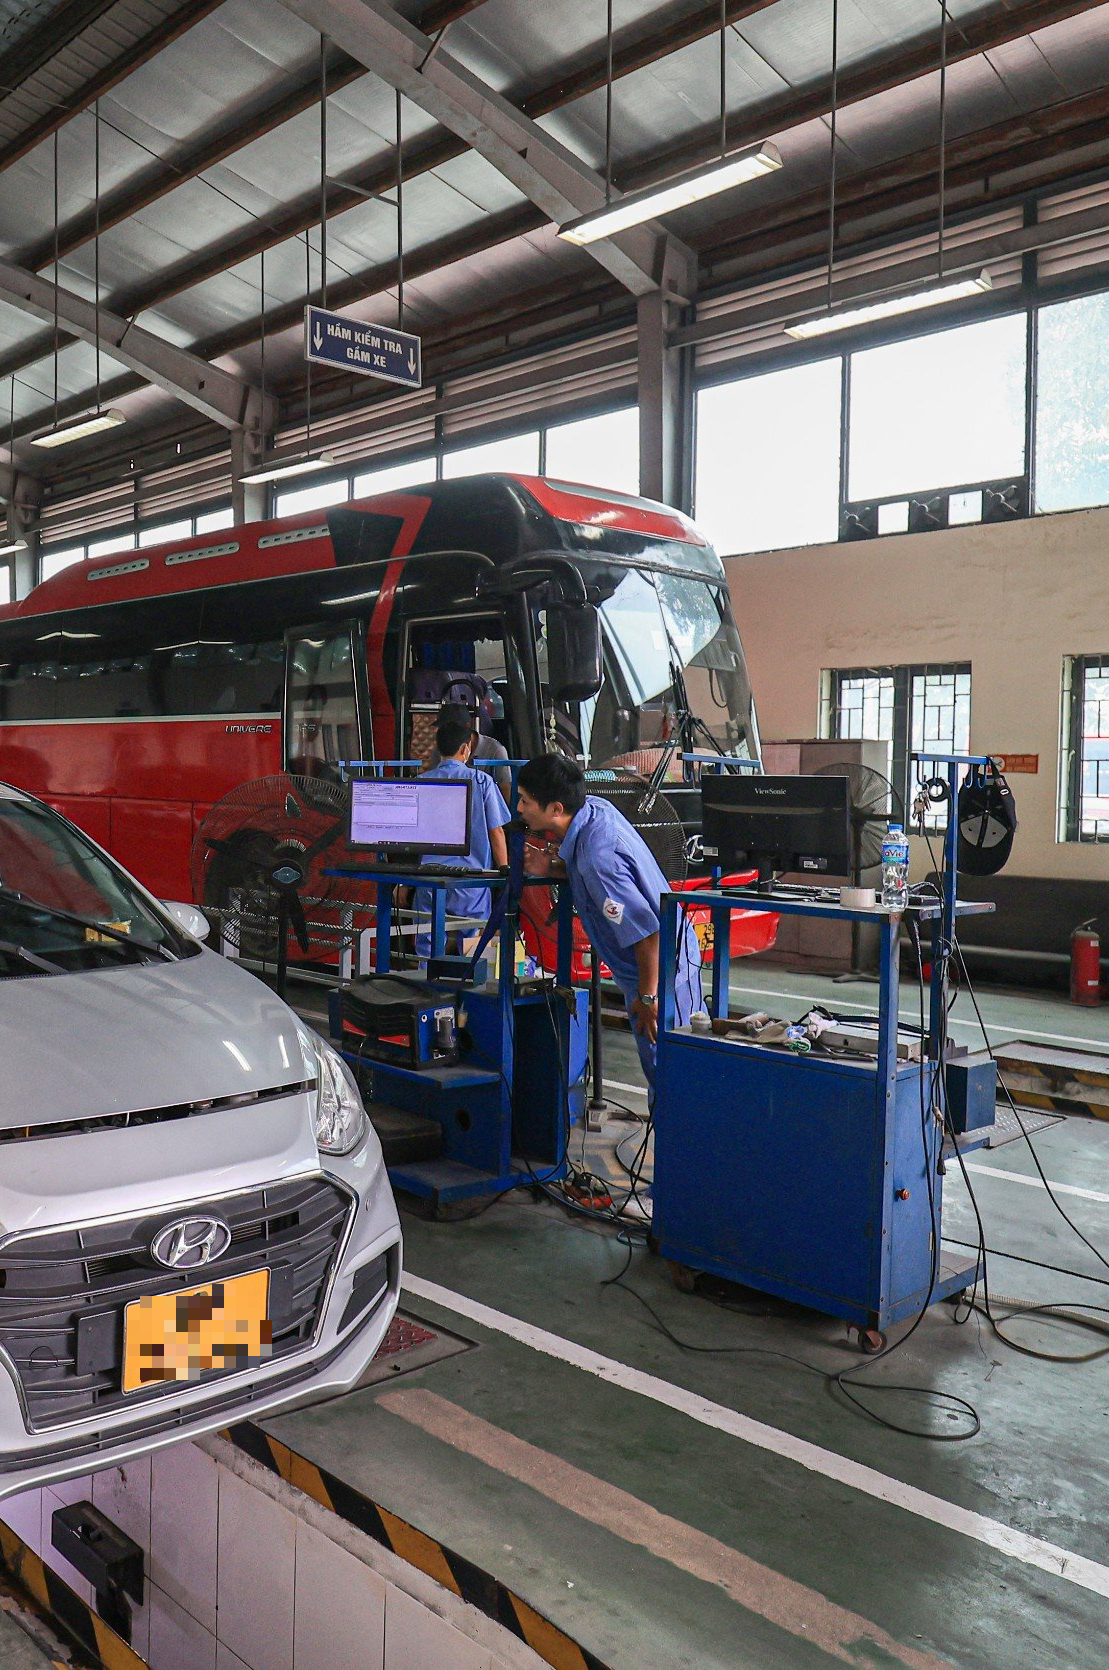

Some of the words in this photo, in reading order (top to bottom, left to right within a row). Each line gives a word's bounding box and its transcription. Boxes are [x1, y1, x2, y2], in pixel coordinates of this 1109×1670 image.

[327, 323, 351, 341] HẦM
[354, 330, 381, 349] KIỂM
[383, 339, 403, 355] TRA
[373, 354, 386, 368] XE
[754, 787, 787, 795] ViewSonic
